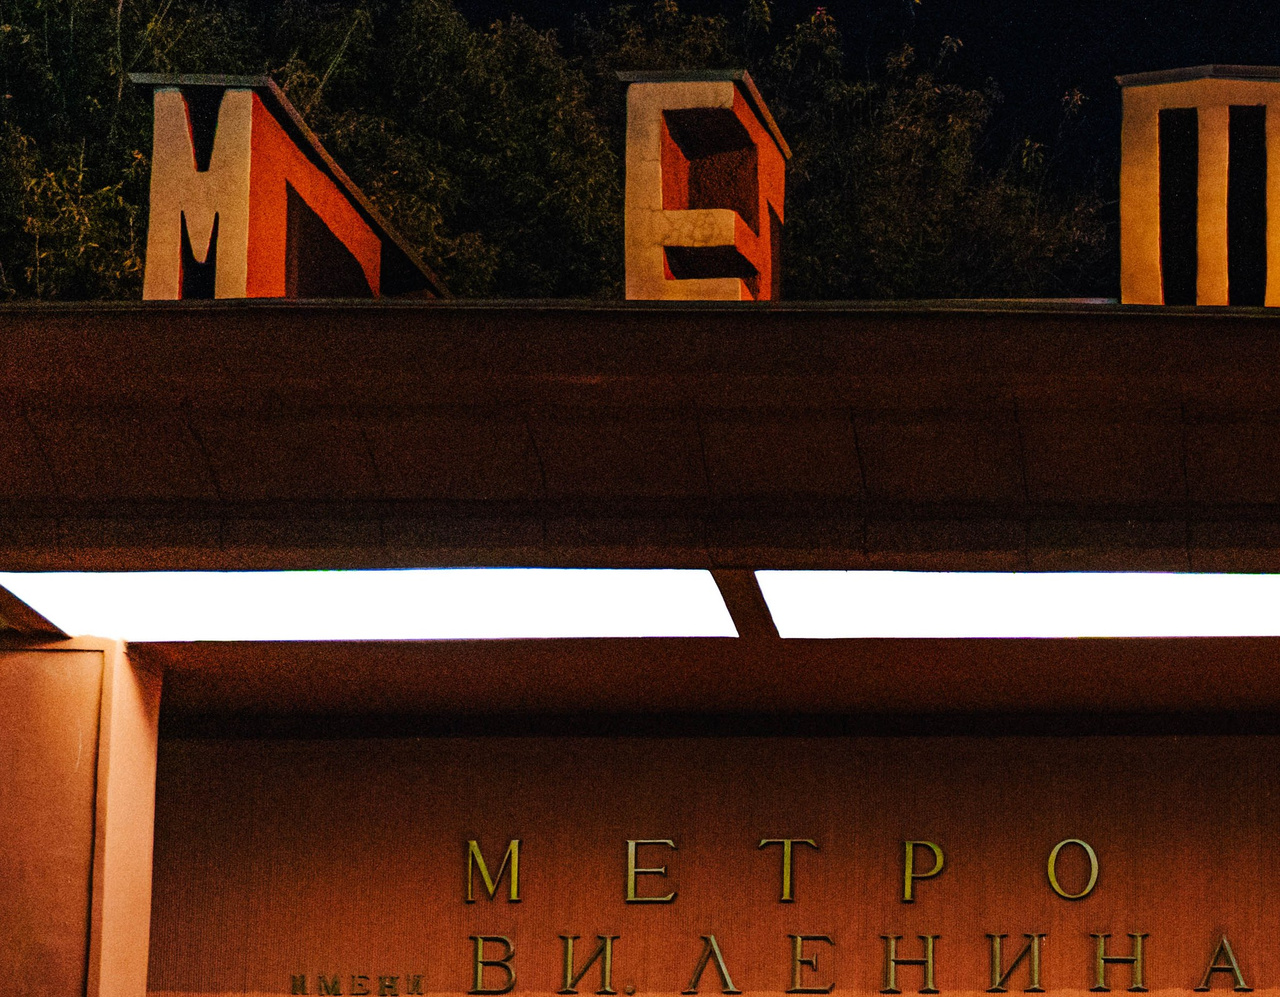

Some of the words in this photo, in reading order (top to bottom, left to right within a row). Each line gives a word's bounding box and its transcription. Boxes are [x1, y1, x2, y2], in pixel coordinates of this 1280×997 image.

[465, 838, 1101, 903] МЕТРО
[290, 973, 425, 997] ИМЕНИ
[681, 933, 1254, 994] ЛЕНИНА
